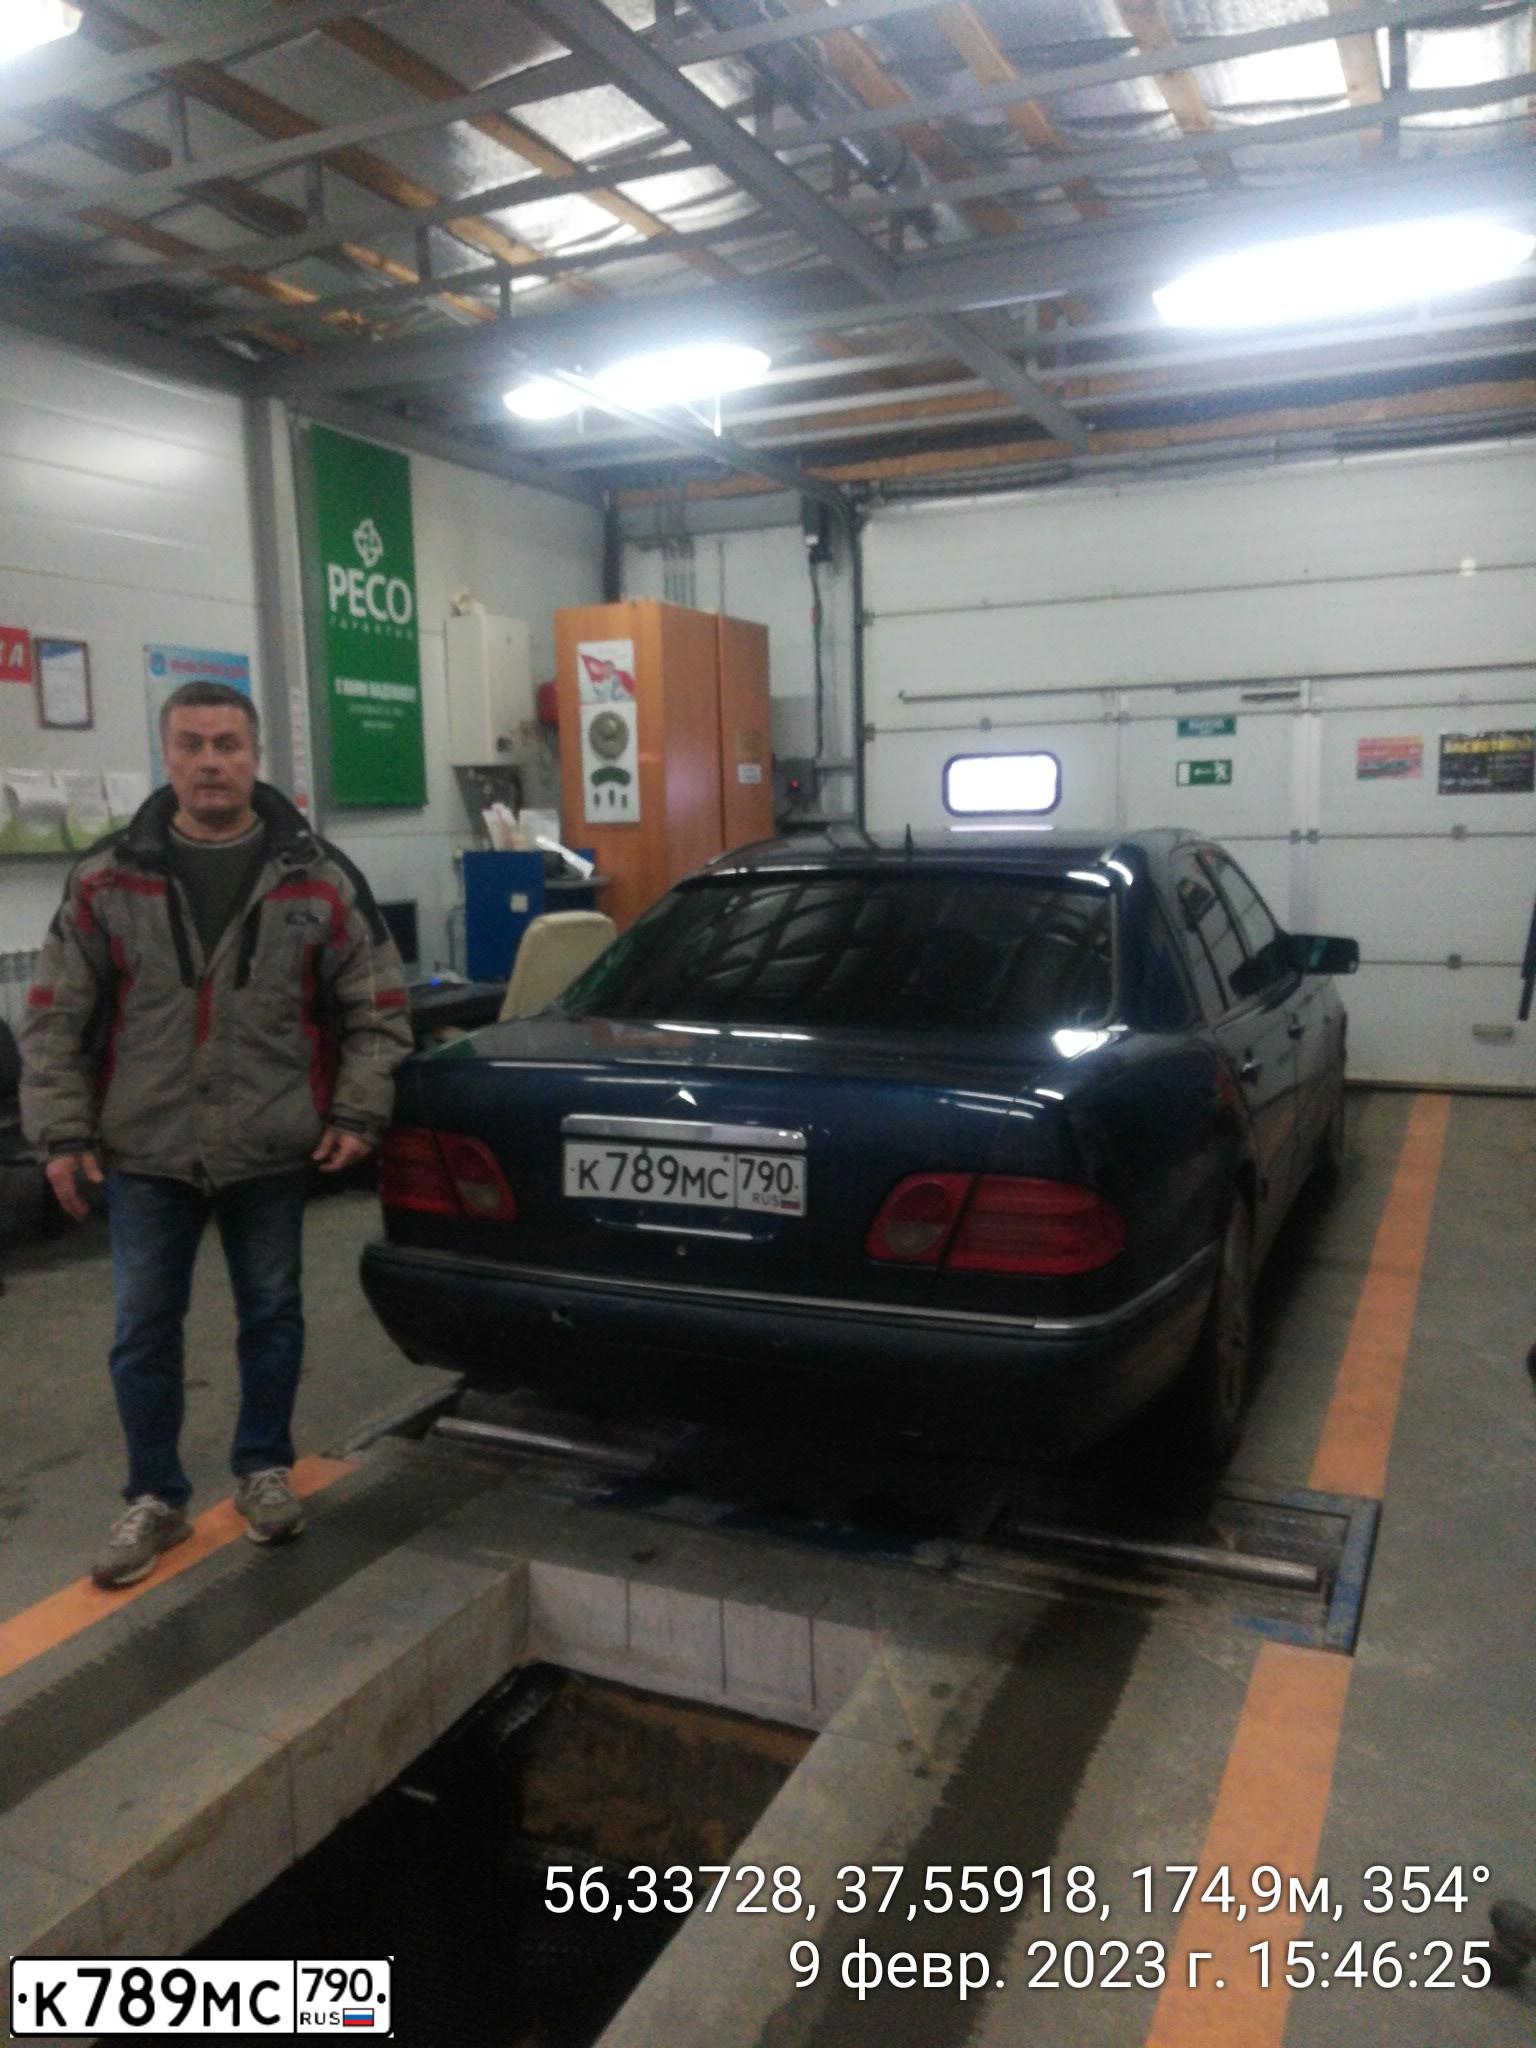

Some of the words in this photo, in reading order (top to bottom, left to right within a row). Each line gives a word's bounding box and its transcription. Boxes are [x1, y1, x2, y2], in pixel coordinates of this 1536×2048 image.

[327, 563, 412, 625] РЕСО
[578, 1151, 729, 1200] К789МС
[738, 1157, 794, 1195] 790
[752, 1192, 780, 1207] RUS
